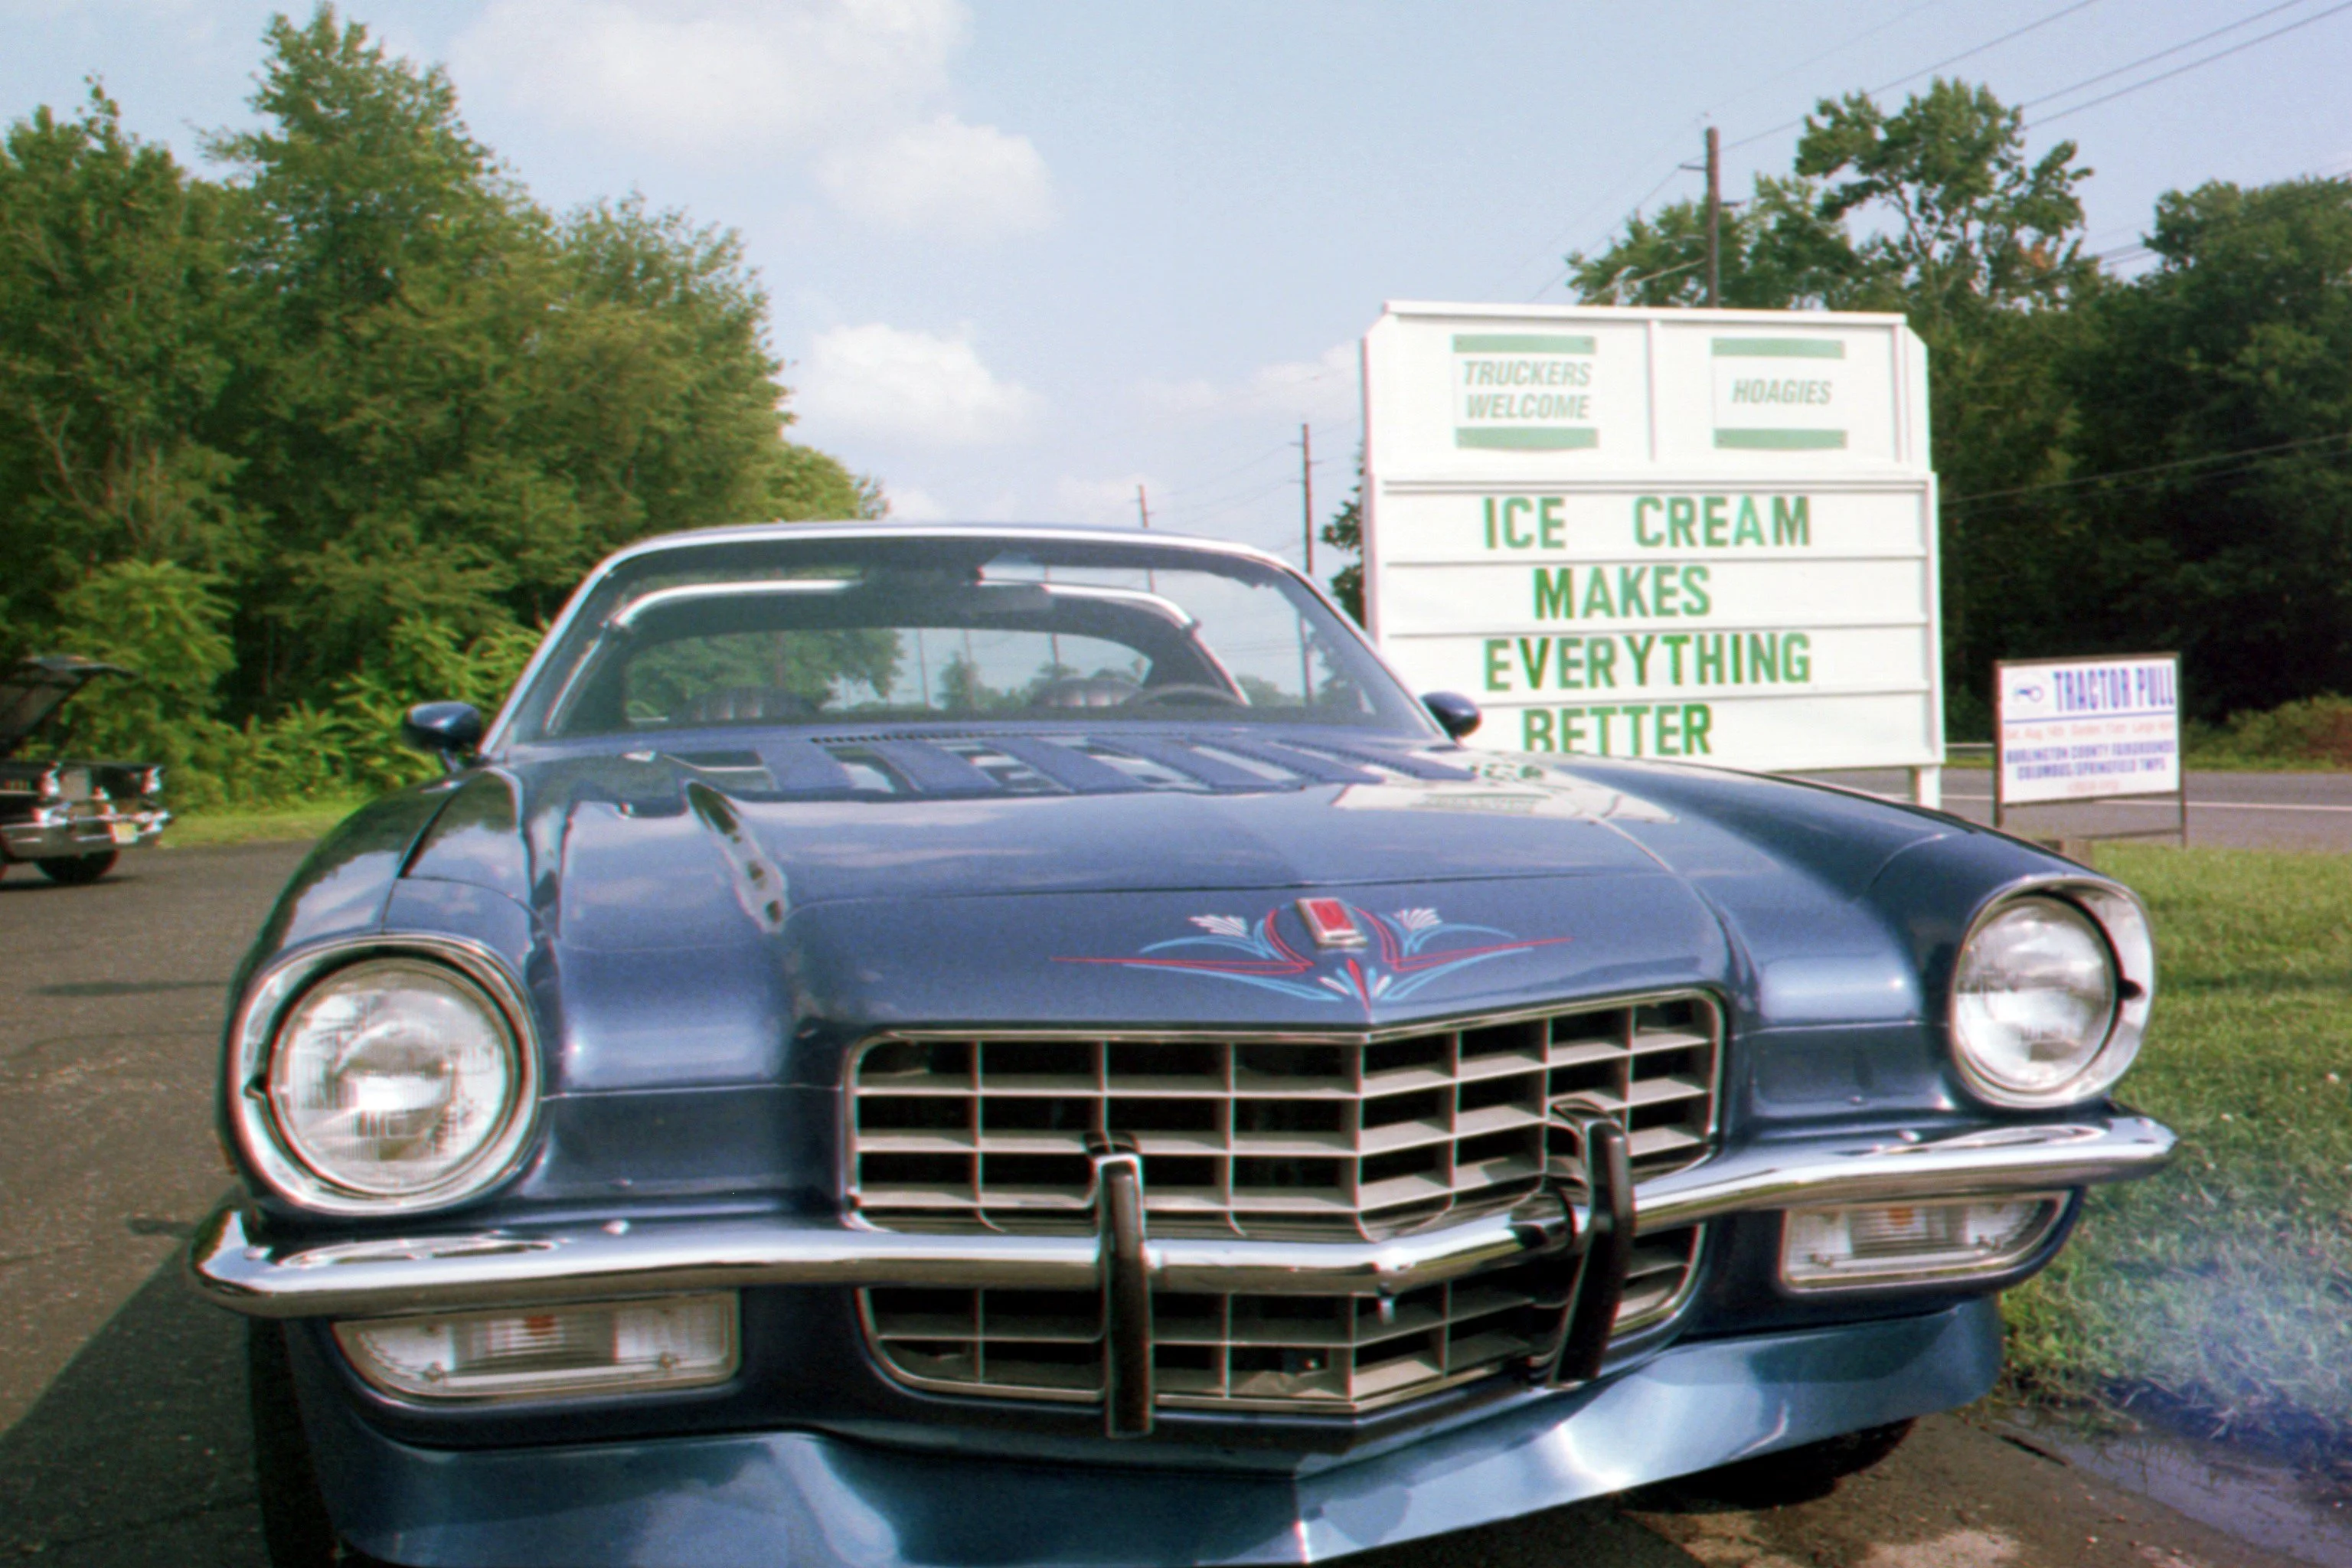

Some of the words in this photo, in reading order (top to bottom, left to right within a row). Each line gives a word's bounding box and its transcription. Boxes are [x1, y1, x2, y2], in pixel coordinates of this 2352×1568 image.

[1463, 360, 1592, 387] TRUCKERS
[1732, 378, 1832, 404] HOAGIES
[1466, 393, 1590, 420] WELCOME
[1483, 497, 1566, 549] ICE
[1633, 494, 1811, 547] CREAM
[1534, 565, 1711, 620] MAKES
[1483, 632, 1811, 691] EVERYTHING
[2053, 667, 2132, 712] TRACTOR
[2137, 665, 2175, 707] PULL
[1522, 703, 1711, 756] BETTER
